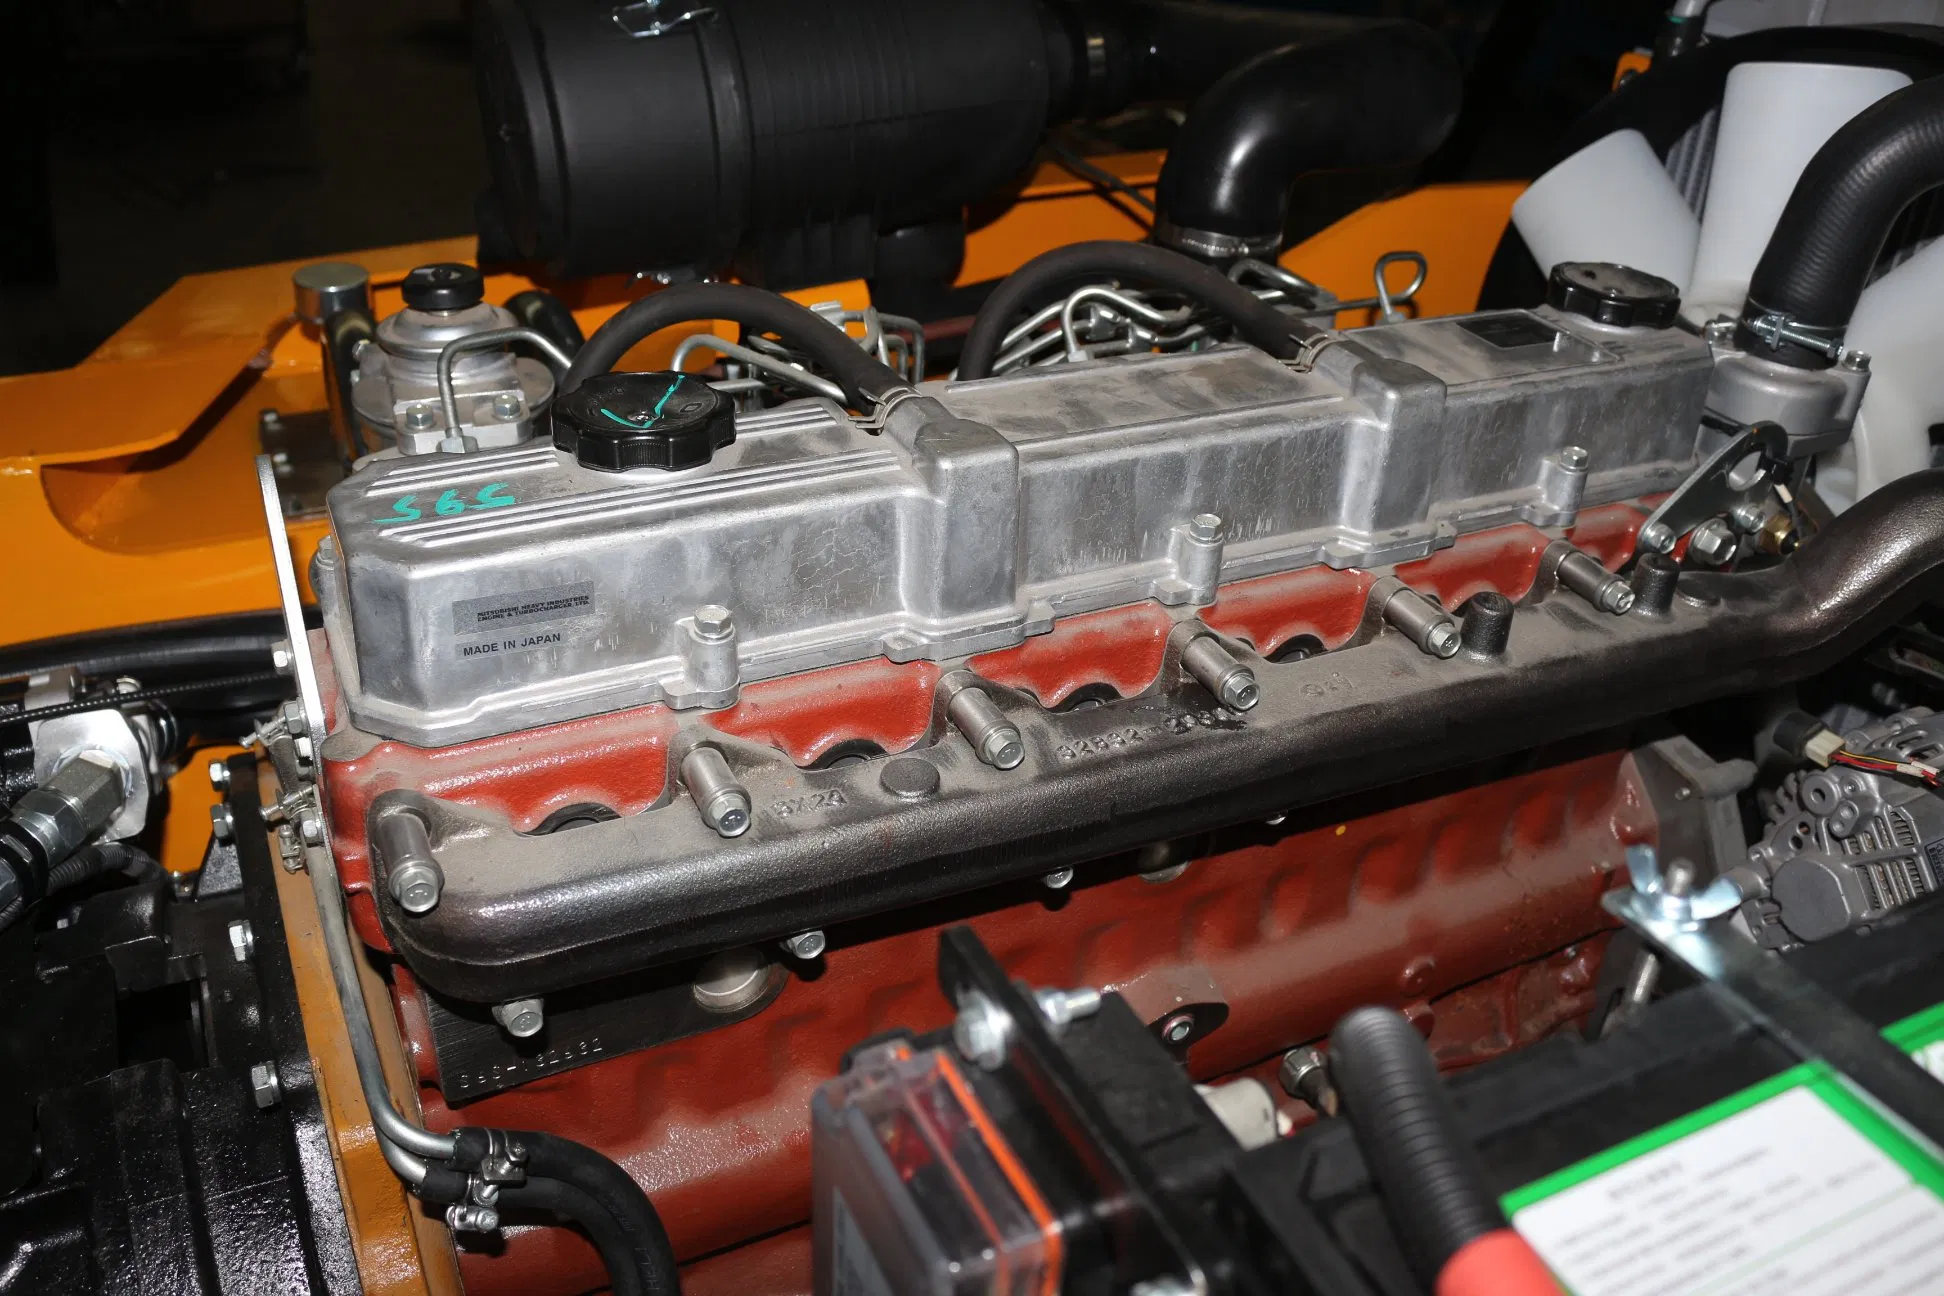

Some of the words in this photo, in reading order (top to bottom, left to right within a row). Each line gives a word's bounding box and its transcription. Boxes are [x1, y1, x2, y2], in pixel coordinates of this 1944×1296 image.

[371, 482, 516, 523] S6S
[521, 602, 545, 611] HEAVY
[546, 595, 590, 606] INDUSTRIES
[477, 614, 505, 622] ENGINE
[463, 642, 499, 657] MADE
[503, 640, 516, 649] IN
[520, 633, 562, 647] JAPAN
